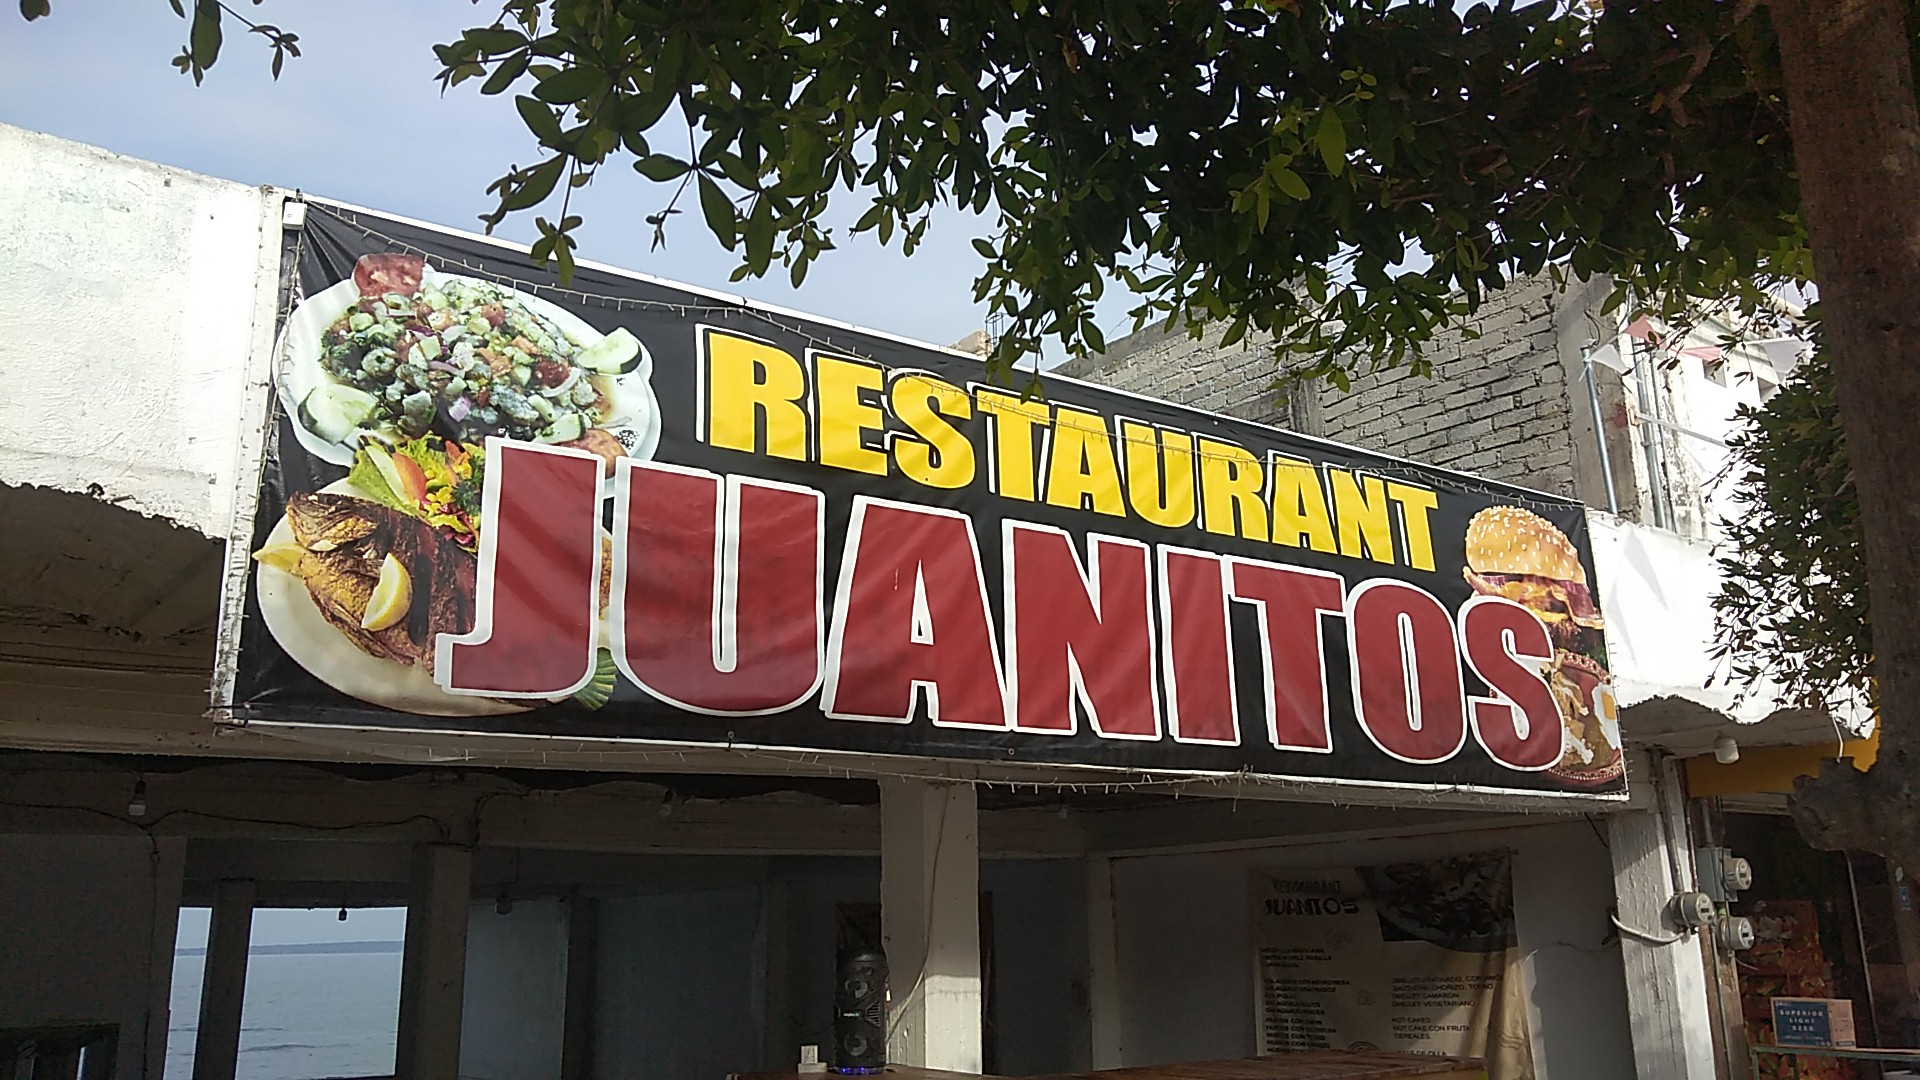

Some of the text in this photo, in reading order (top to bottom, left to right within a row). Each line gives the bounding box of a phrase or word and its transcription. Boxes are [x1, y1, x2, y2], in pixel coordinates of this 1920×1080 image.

[697, 323, 1438, 573] RESTAURANT
[436, 437, 1563, 772] JUANITOS
[1779, 1009, 1823, 1017] SUPERIOR
